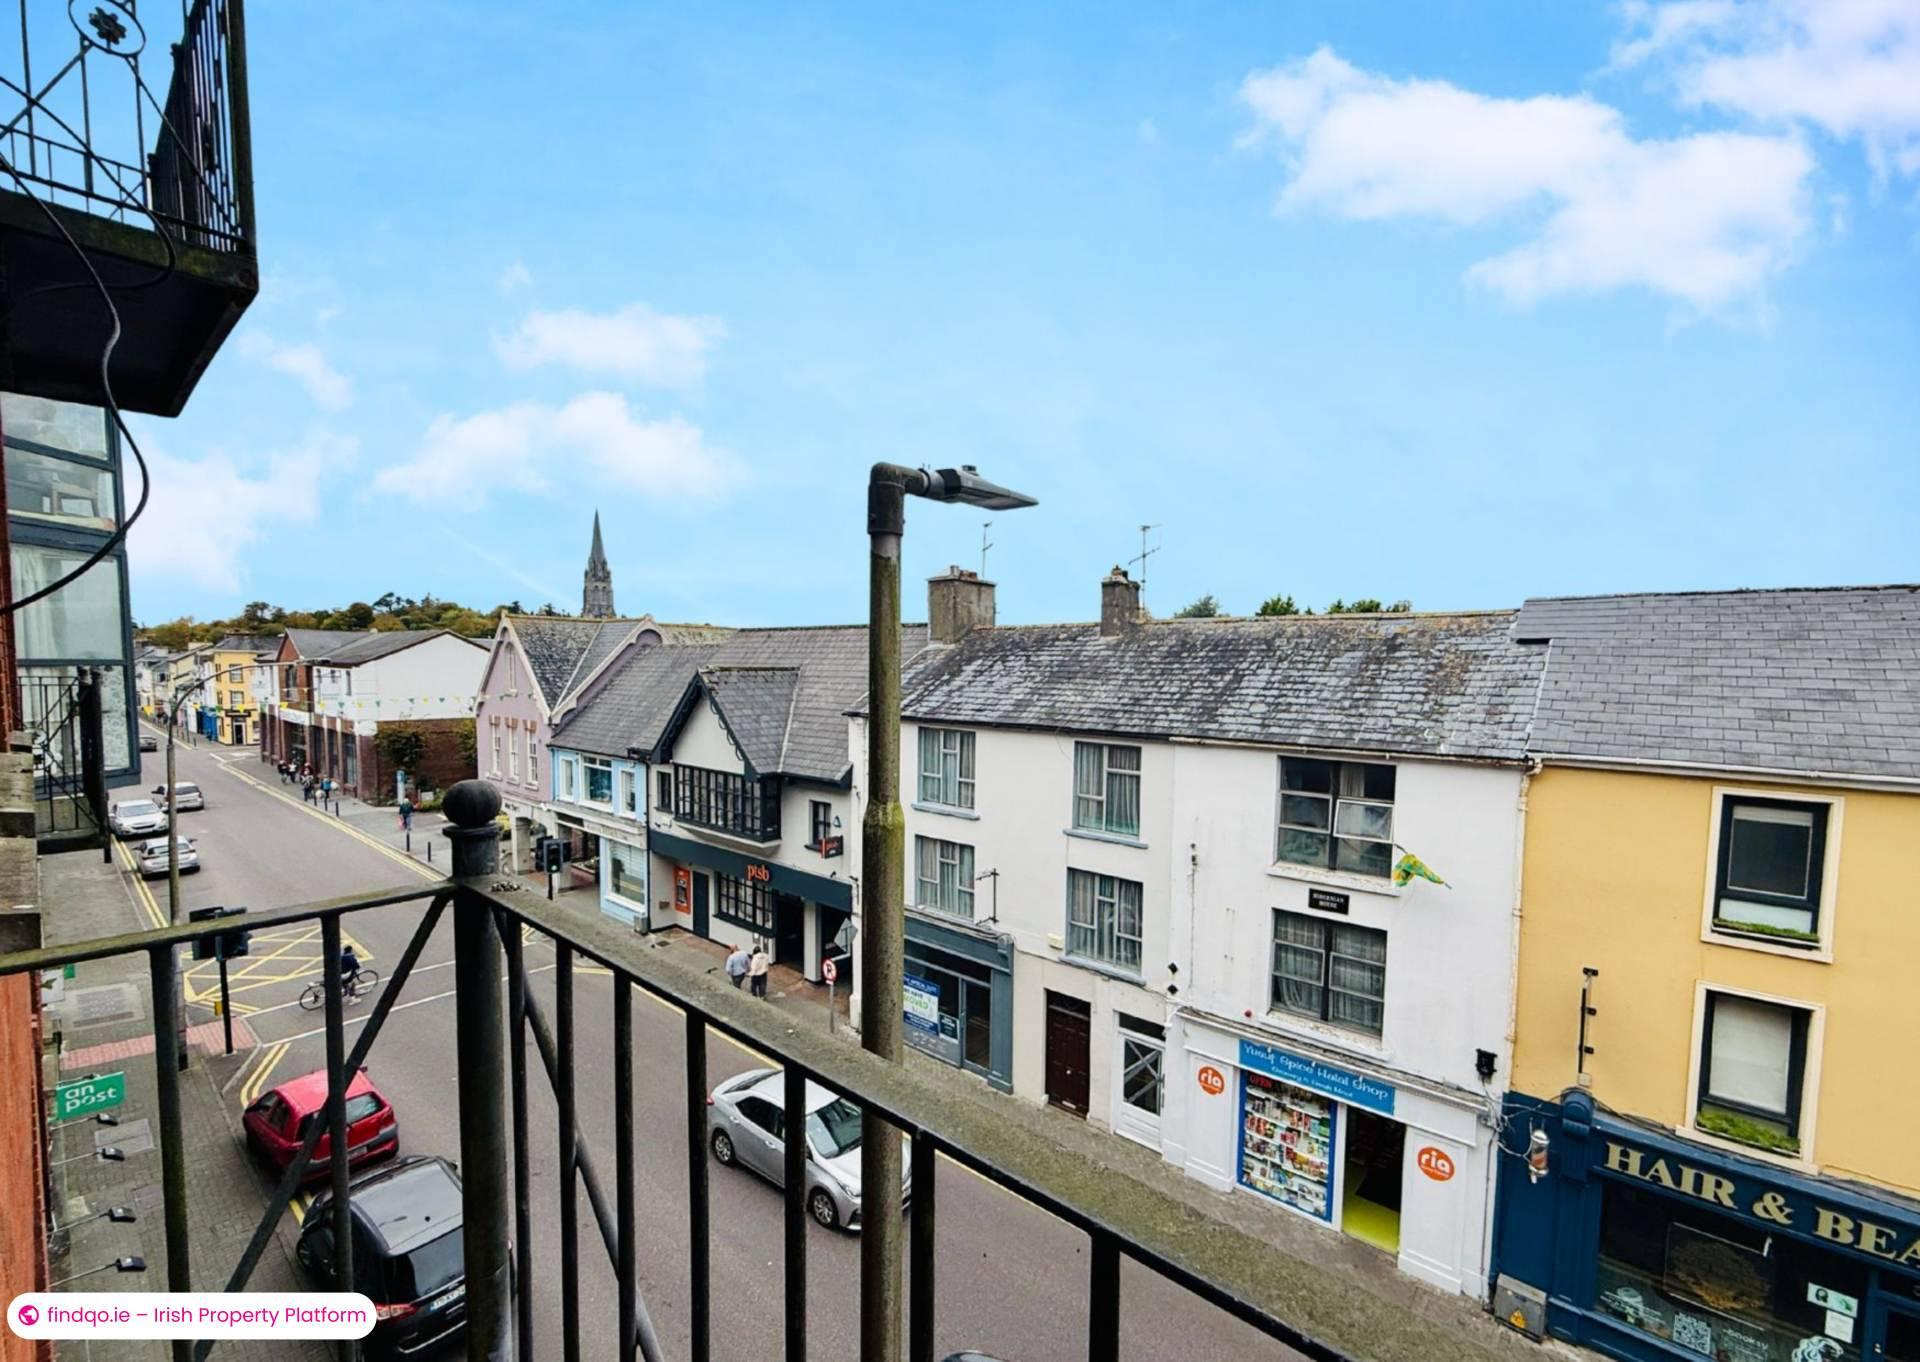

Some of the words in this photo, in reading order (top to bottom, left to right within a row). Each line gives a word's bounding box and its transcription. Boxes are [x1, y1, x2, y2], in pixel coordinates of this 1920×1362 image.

[747, 864, 769, 881] ptsb
[1201, 1069, 1222, 1088] ria
[1317, 1067, 1349, 1086] Halal
[1352, 1078, 1389, 1100] Shop
[65, 1084, 95, 1100] an
[66, 1087, 117, 1112] post
[1421, 1150, 1450, 1174] ria
[1605, 1141, 1738, 1210] HAIR
[1752, 1191, 1795, 1225] &
